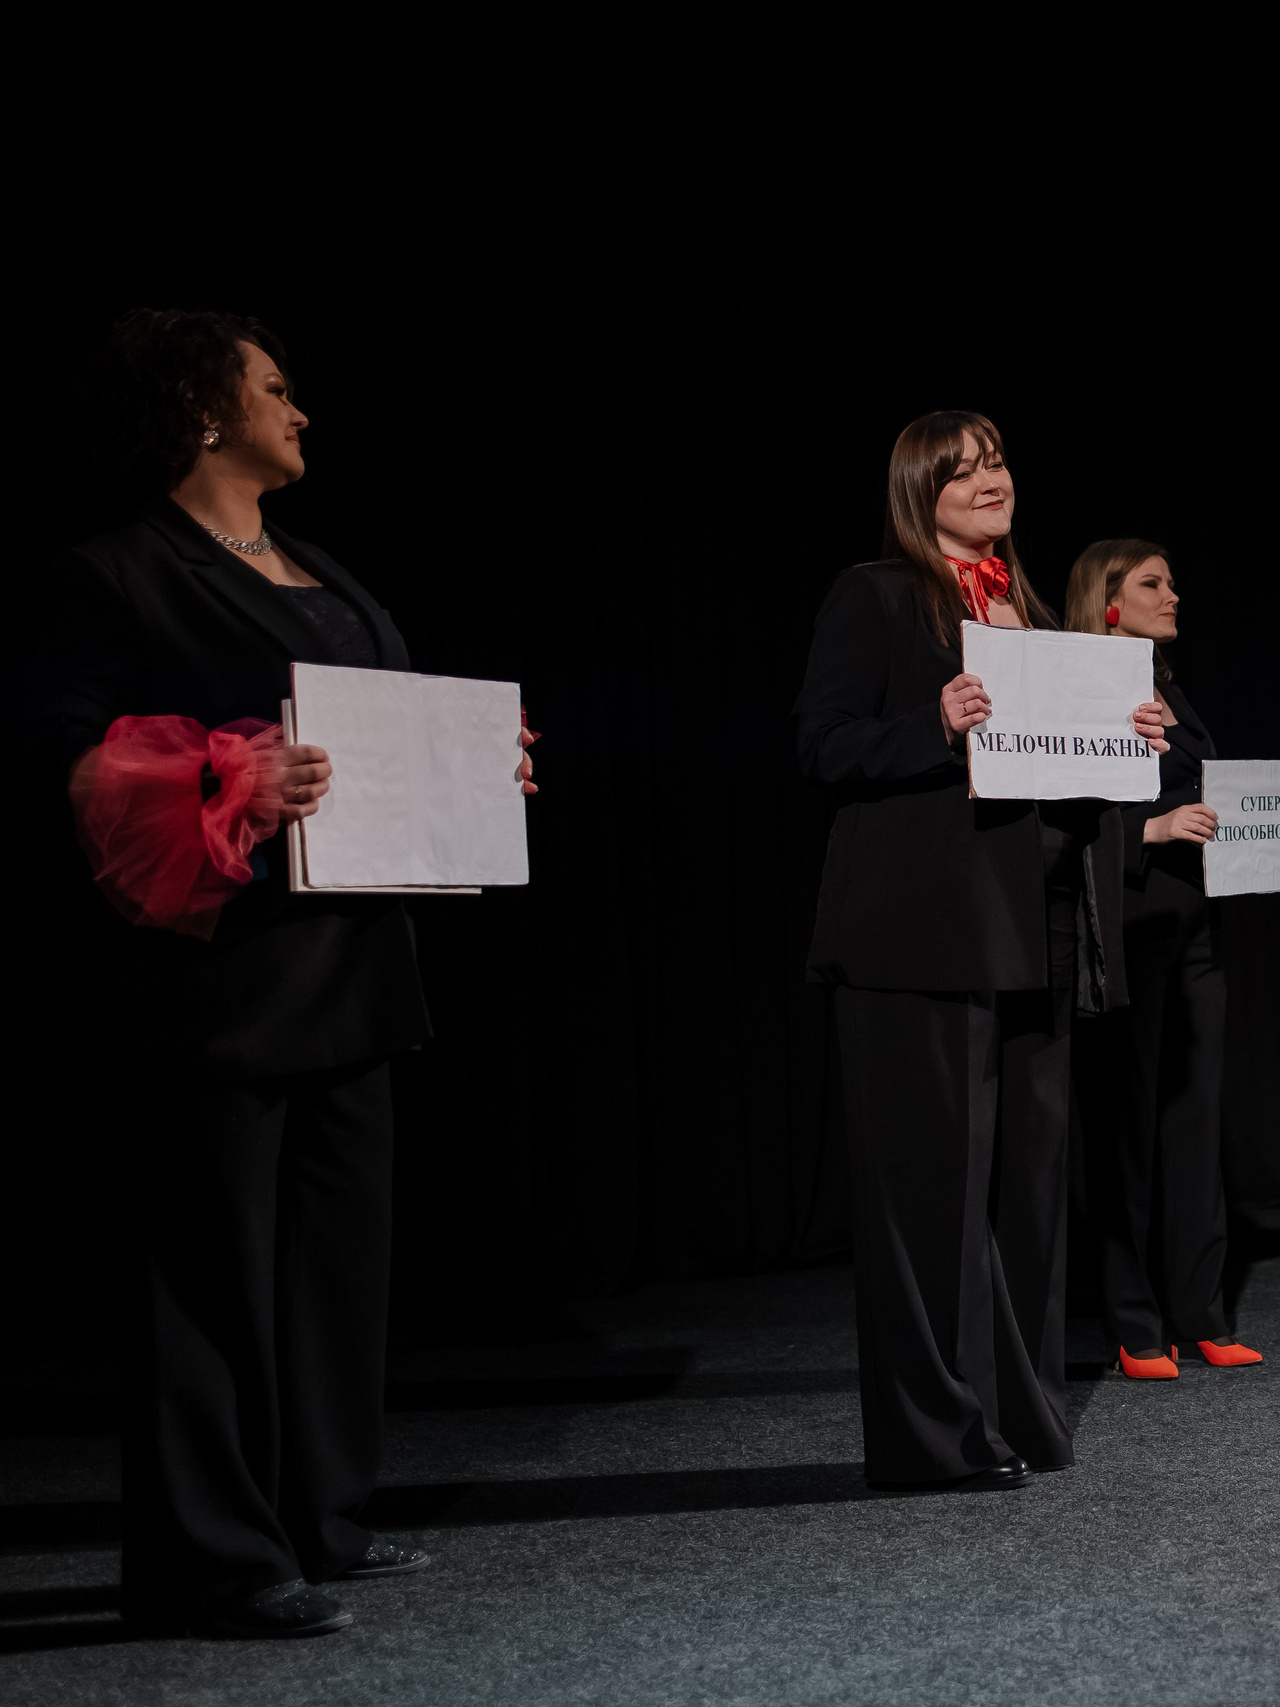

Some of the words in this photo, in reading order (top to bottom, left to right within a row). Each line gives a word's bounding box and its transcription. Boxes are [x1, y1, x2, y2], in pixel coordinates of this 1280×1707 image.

[976, 732, 1066, 755] МЕЛОЧИ
[1072, 736, 1151, 759] ВАЖНЫ
[1241, 795, 1280, 812] СУПЕР
